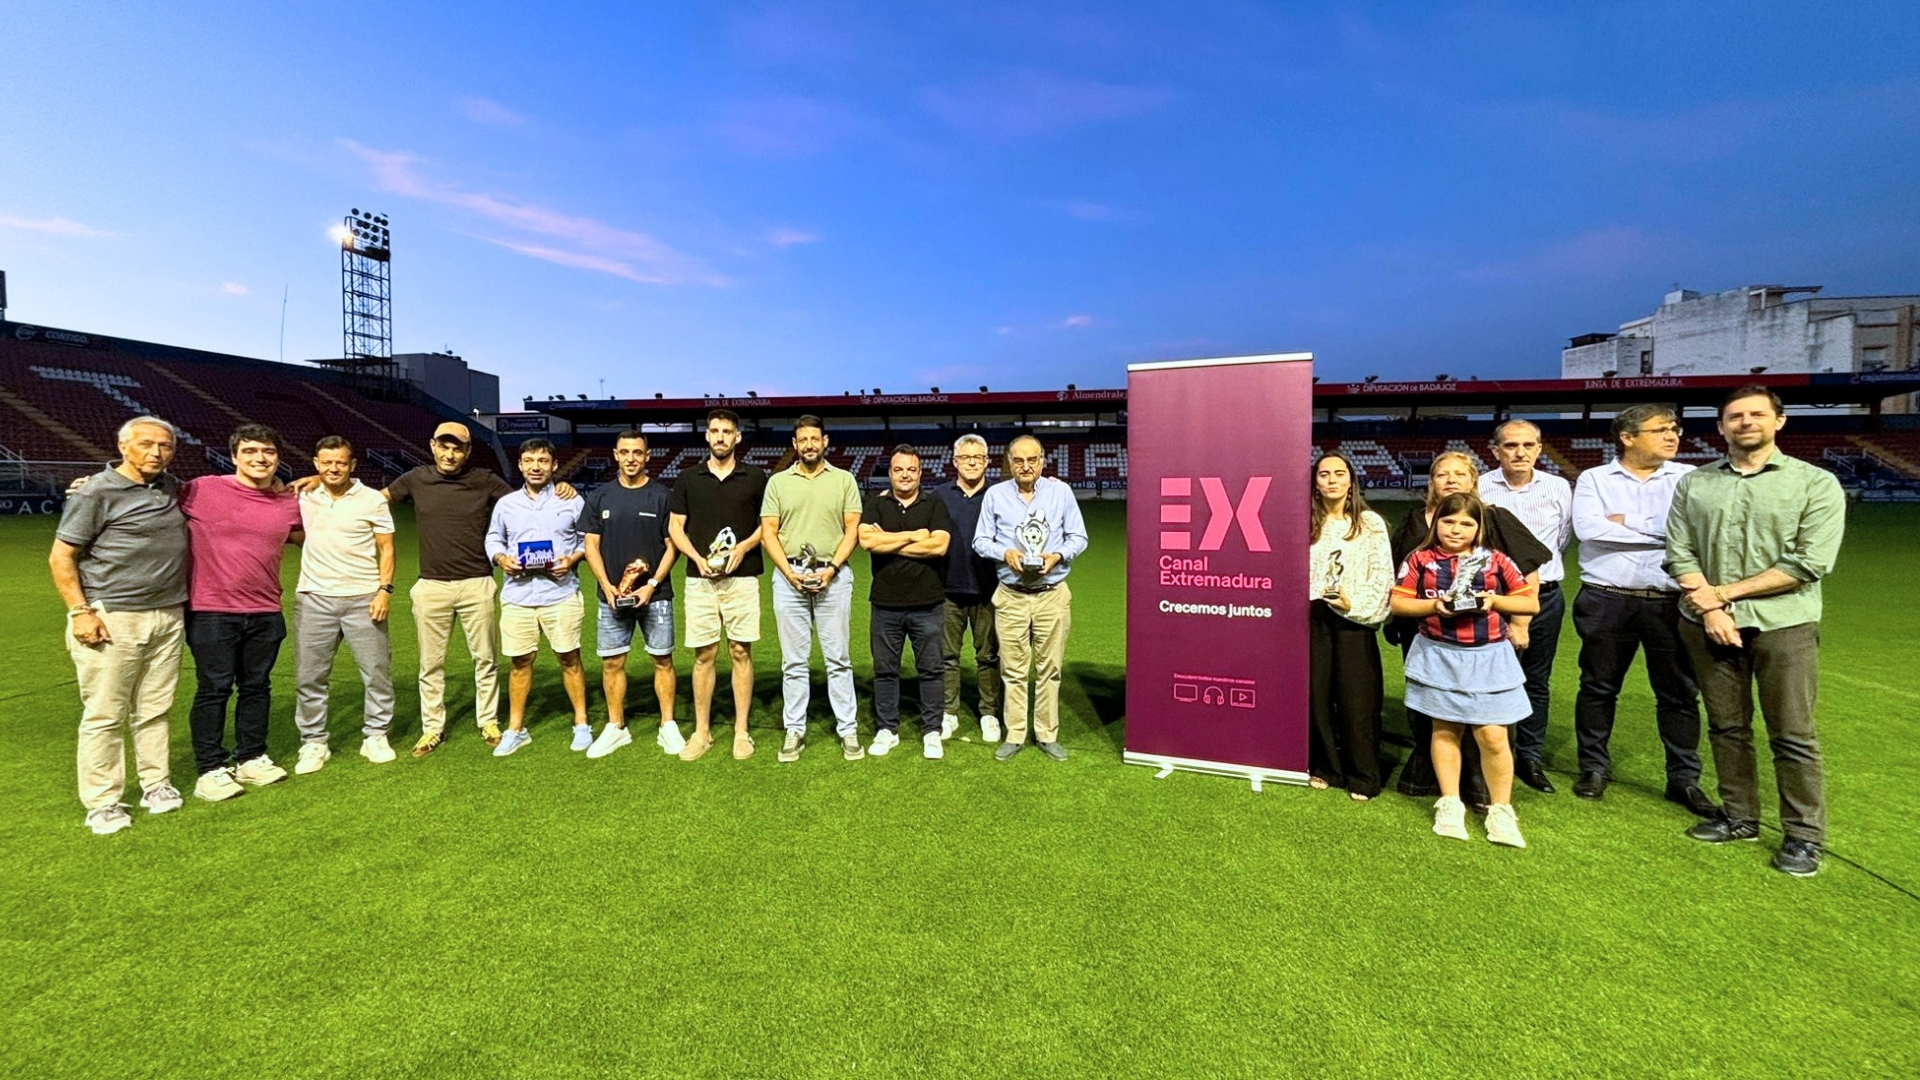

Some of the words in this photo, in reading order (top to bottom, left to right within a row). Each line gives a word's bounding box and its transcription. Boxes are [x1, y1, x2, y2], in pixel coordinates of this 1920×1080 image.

[1420, 383, 1457, 391] BADAJOZ
[1585, 380, 1608, 390] JUNTA
[1611, 380, 1621, 388] DE
[1625, 378, 1684, 388] EXTREMADURA
[918, 395, 949, 403] BADAJOZ
[1072, 391, 1128, 400] Almendralej
[704, 399, 720, 408] JUNTA
[722, 399, 729, 407] DE
[732, 398, 772, 407] EXTREMADURA
[1160, 476, 1273, 552] EX
[1159, 555, 1208, 571] Canal
[1160, 570, 1272, 589] Extremadura
[1159, 600, 1227, 616] Crecemos
[1228, 603, 1272, 618] juntos
